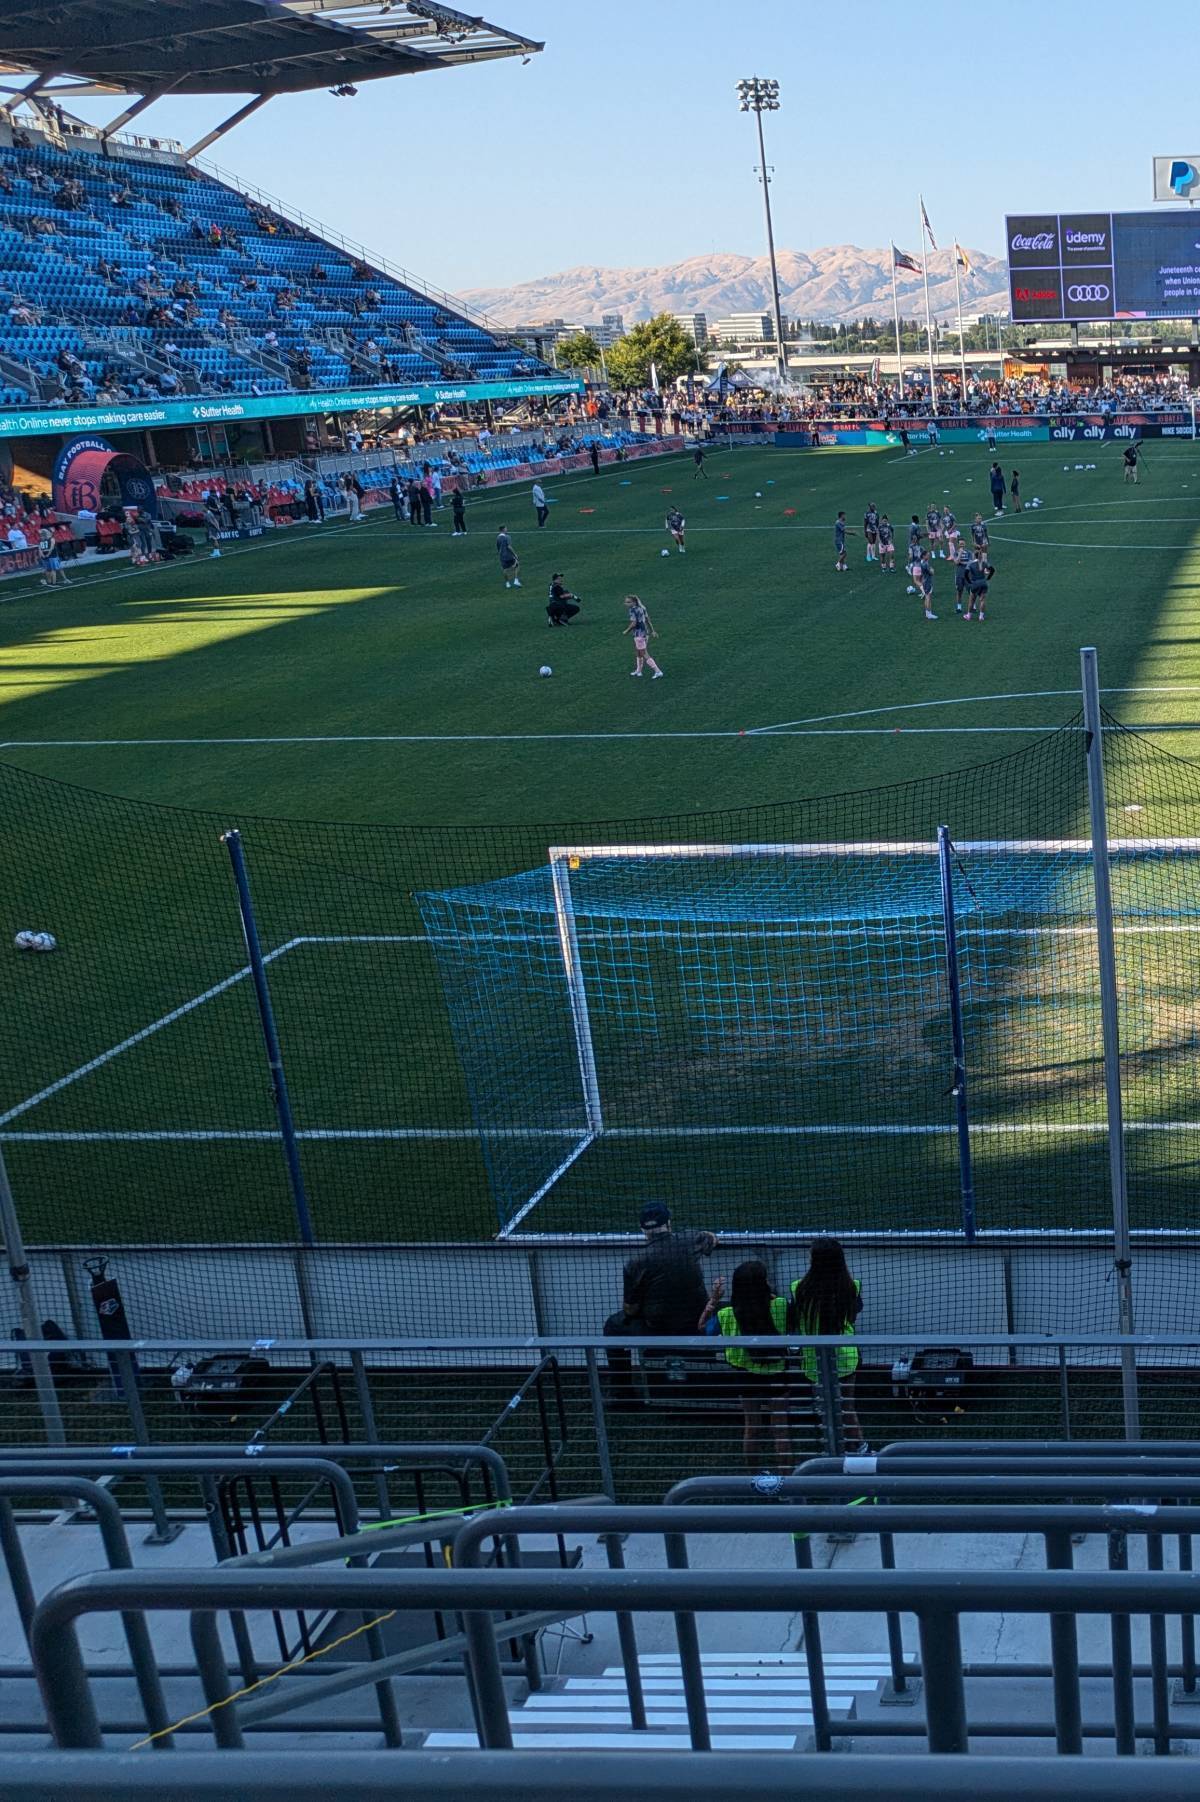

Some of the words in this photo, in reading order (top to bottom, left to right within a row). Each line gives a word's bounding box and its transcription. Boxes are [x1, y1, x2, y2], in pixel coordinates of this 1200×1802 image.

[1159, 264, 1193, 274] Juneteenth
[1165, 276, 1181, 285] when
[1183, 276, 1200, 285] Union
[1164, 288, 1184, 298] people
[1186, 287, 1192, 296] in
[365, 396, 378, 406] stops
[379, 394, 397, 404] making
[440, 390, 452, 399] Sutter
[453, 389, 466, 398] Health
[201, 406, 222, 418] Sutter
[222, 404, 244, 416] Health
[20, 417, 48, 429] Online
[50, 417, 72, 427] never
[74, 415, 96, 427] stops
[98, 412, 126, 425] making
[127, 412, 143, 421] care
[144, 410, 166, 420] easier.
[1011, 430, 1033, 438] Health
[1053, 426, 1076, 441] ally
[1084, 425, 1106, 440] ally
[1114, 425, 1136, 439] ally
[1162, 427, 1175, 435] NIKE
[59, 458, 68, 480] BAY
[68, 440, 106, 459] FOOTBALL
